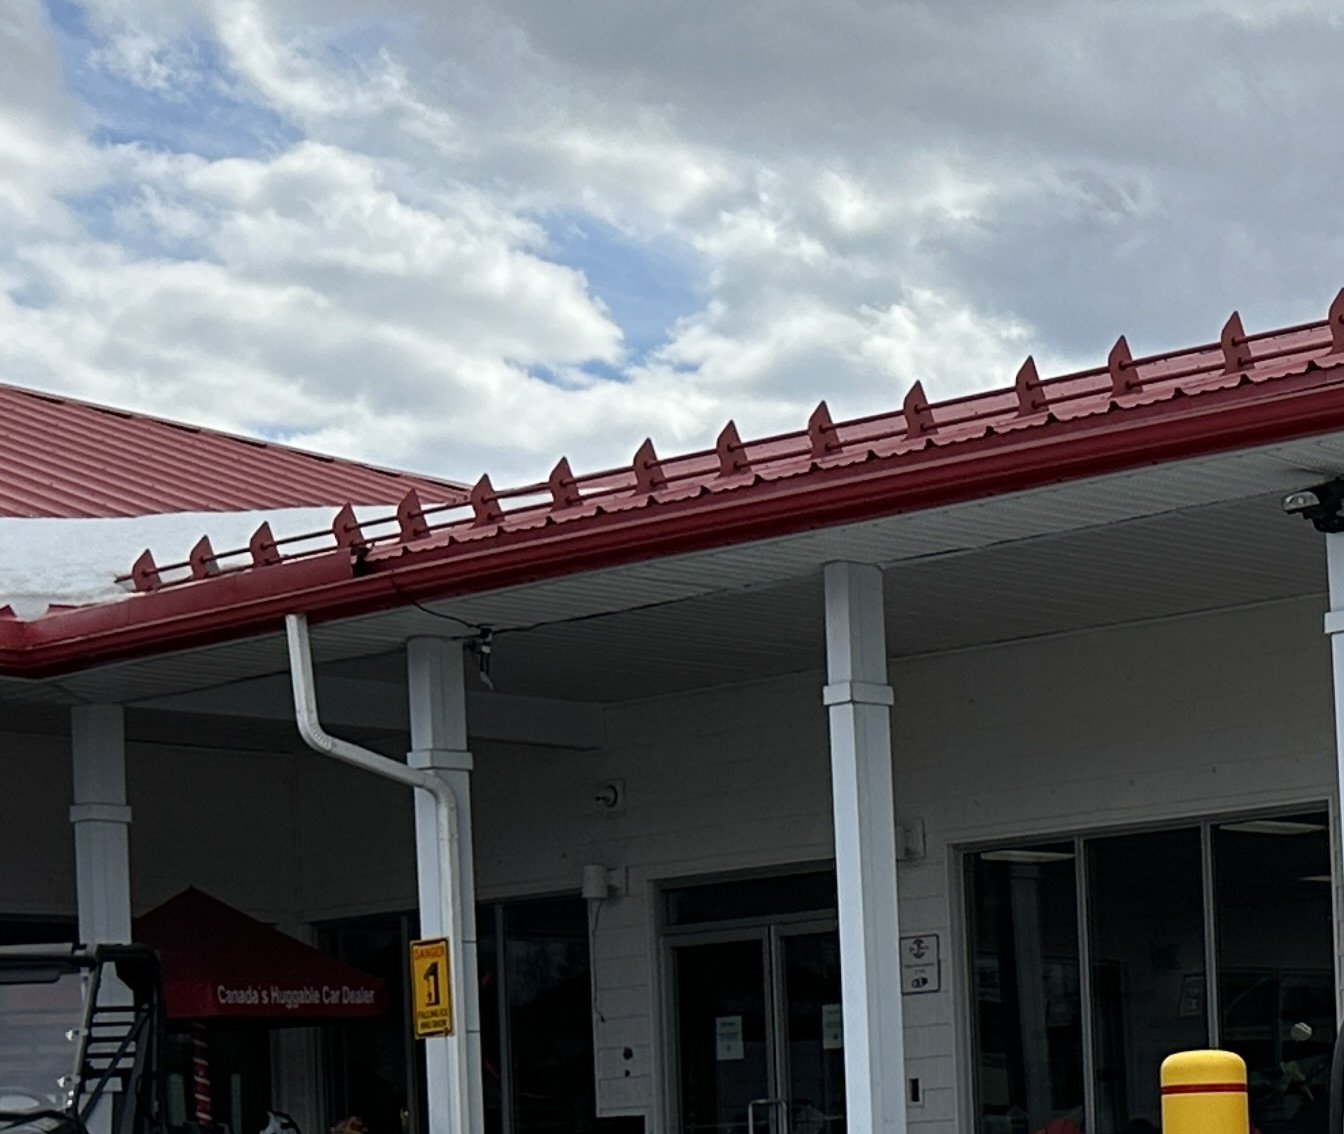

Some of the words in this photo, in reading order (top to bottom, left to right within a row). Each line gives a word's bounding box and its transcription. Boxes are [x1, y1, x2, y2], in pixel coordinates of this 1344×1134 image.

[217, 984, 269, 1005] Canada's
[270, 985, 320, 1009] Huggable
[322, 985, 340, 1004] Car
[342, 984, 375, 1004] Dealer
